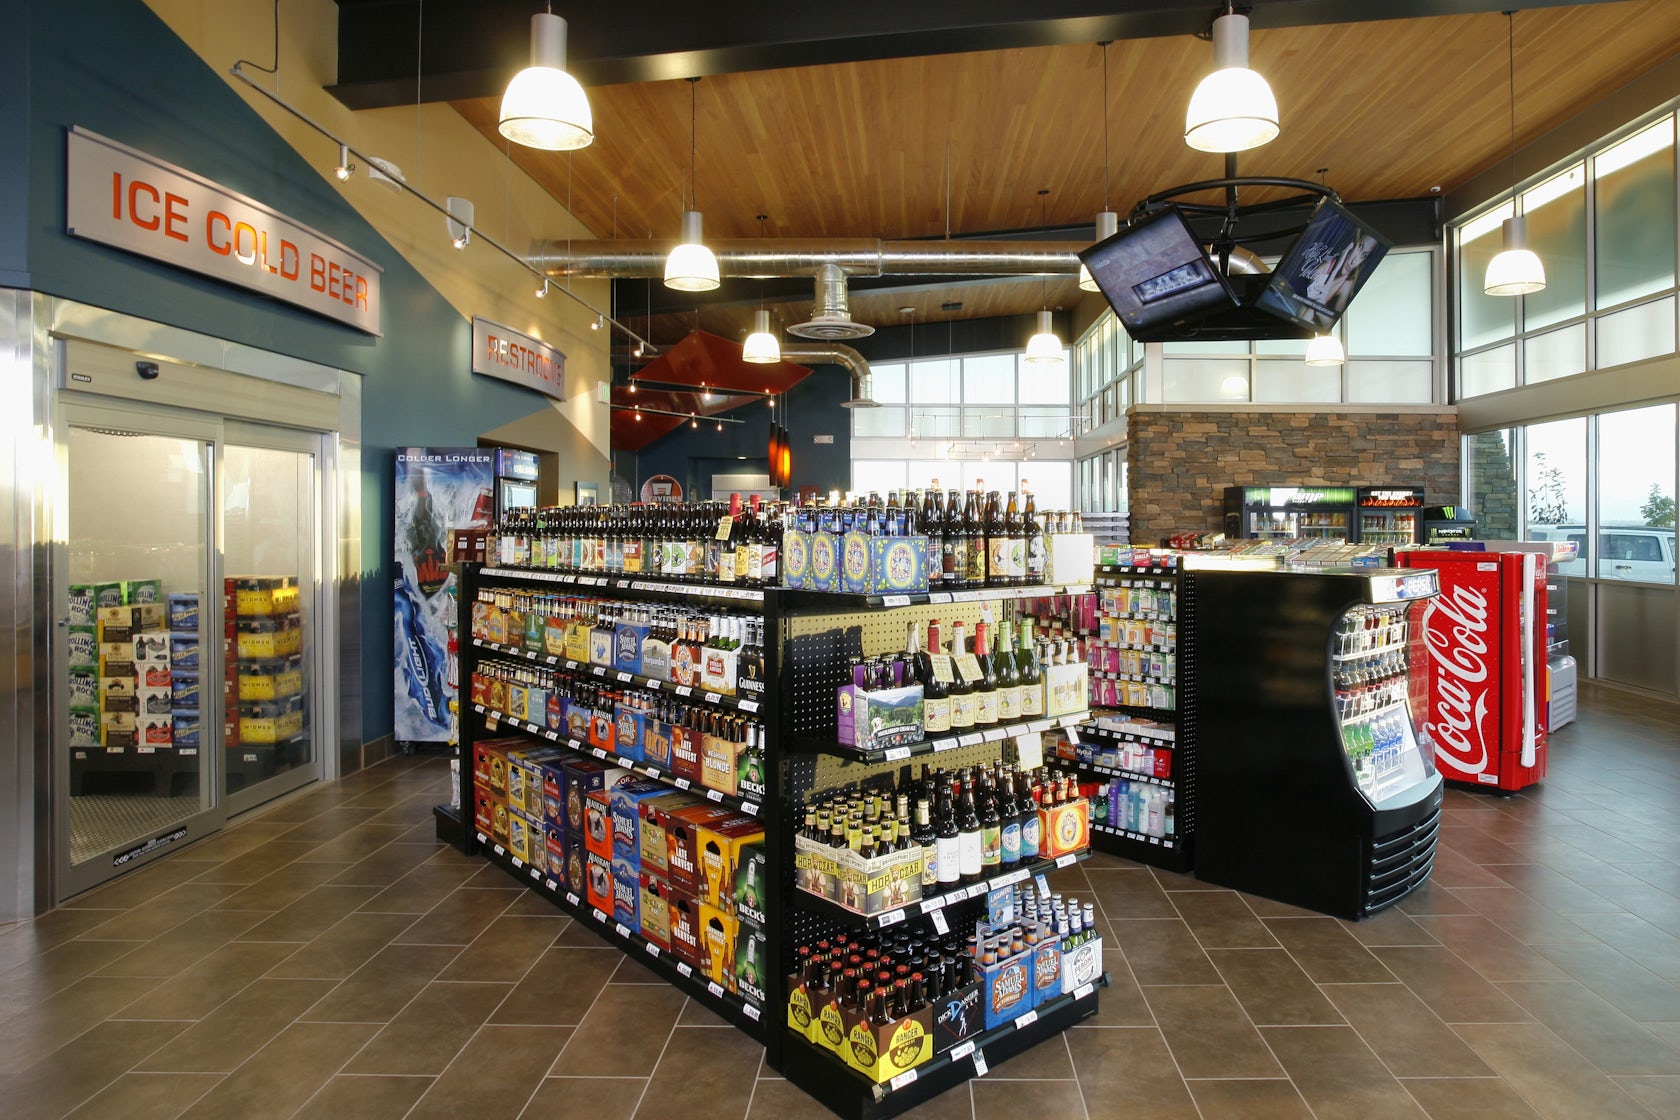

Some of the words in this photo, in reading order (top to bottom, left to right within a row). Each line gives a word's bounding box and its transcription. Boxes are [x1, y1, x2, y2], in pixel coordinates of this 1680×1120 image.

[112, 172, 189, 242] ICE
[206, 210, 299, 281] COLD
[310, 253, 368, 312] BEER
[398, 454, 442, 462] COLDER
[446, 455, 490, 463] LONGER
[408, 637, 426, 681] LIGHT
[1422, 584, 1489, 775] Coca-Cola
[423, 688, 437, 720] BUD
[676, 846, 688, 860] LATE
[671, 854, 694, 873] HARVEST
[798, 857, 812, 868] HOP
[818, 860, 835, 873] CZAR
[851, 873, 867, 884] CZAR
[871, 874, 891, 892] HOP
[899, 862, 919, 879] CZAR
[739, 902, 765, 924] BECK'S
[678, 919, 690, 934] LATE
[673, 926, 697, 947] HARVEST
[738, 977, 765, 1001] BECK'S
[995, 971, 1024, 993] SAMUEL
[793, 992, 809, 1008] RANGER
[824, 1010, 841, 1025] RANGER
[937, 1009, 952, 1024] DICK
[853, 1029, 874, 1046] RANGER
[896, 1027, 918, 1044] RANGER
